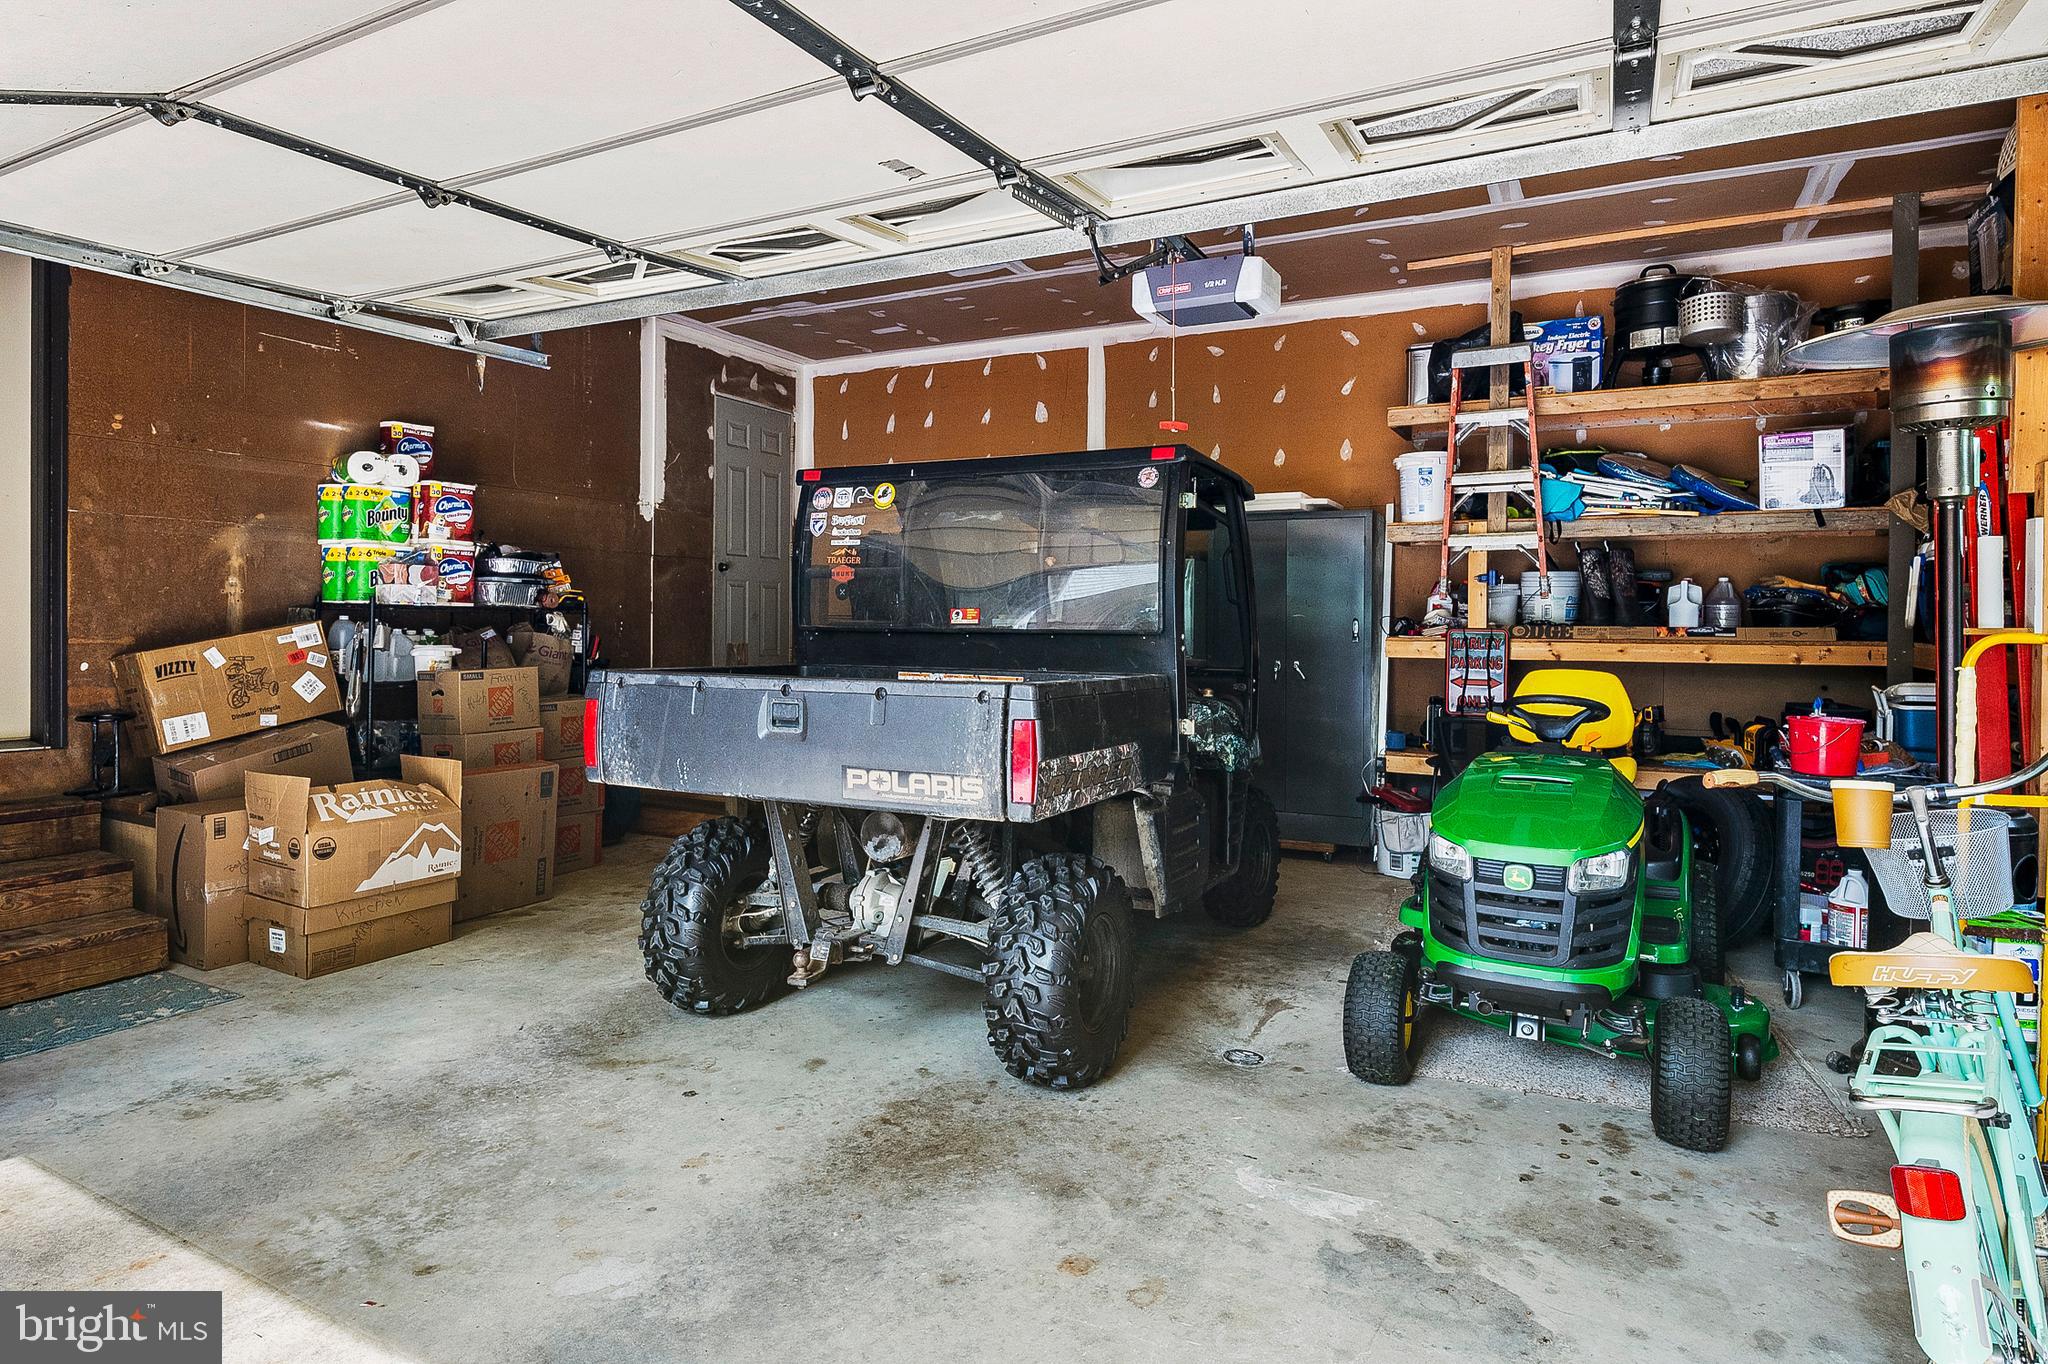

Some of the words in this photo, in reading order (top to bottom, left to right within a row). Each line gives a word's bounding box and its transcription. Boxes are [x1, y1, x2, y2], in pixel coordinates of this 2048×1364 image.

[1204, 279, 1214, 288] 1/2
[1547, 333, 1568, 341] Indoor
[1568, 331, 1591, 339] Electric
[1556, 339, 1589, 352] Fryer
[401, 441, 426, 452] Charmin
[438, 500, 466, 511] Charmin
[367, 506, 408, 528] Bounty
[1979, 492, 1989, 537] WERNER
[827, 556, 861, 564] TRAEGER
[440, 562, 466, 574] Charmin
[1452, 636, 1502, 651] HARLEY
[538, 644, 568, 661] Giant
[154, 660, 197, 679] VIZZTY
[1451, 655, 1503, 670] PARKING
[462, 672, 483, 680] SMALL
[1457, 695, 1496, 708] ONLY
[231, 709, 257, 721] Dinosaur
[258, 703, 281, 714] Tricycle
[846, 767, 985, 800] POLARIS
[1044, 757, 1134, 799] RANGER
[309, 785, 430, 823] Rainier
[393, 803, 438, 813] ORGANIC
[317, 841, 332, 849] USDA
[334, 893, 407, 924] Kitchen
[1872, 966, 1978, 985] HUFFY
